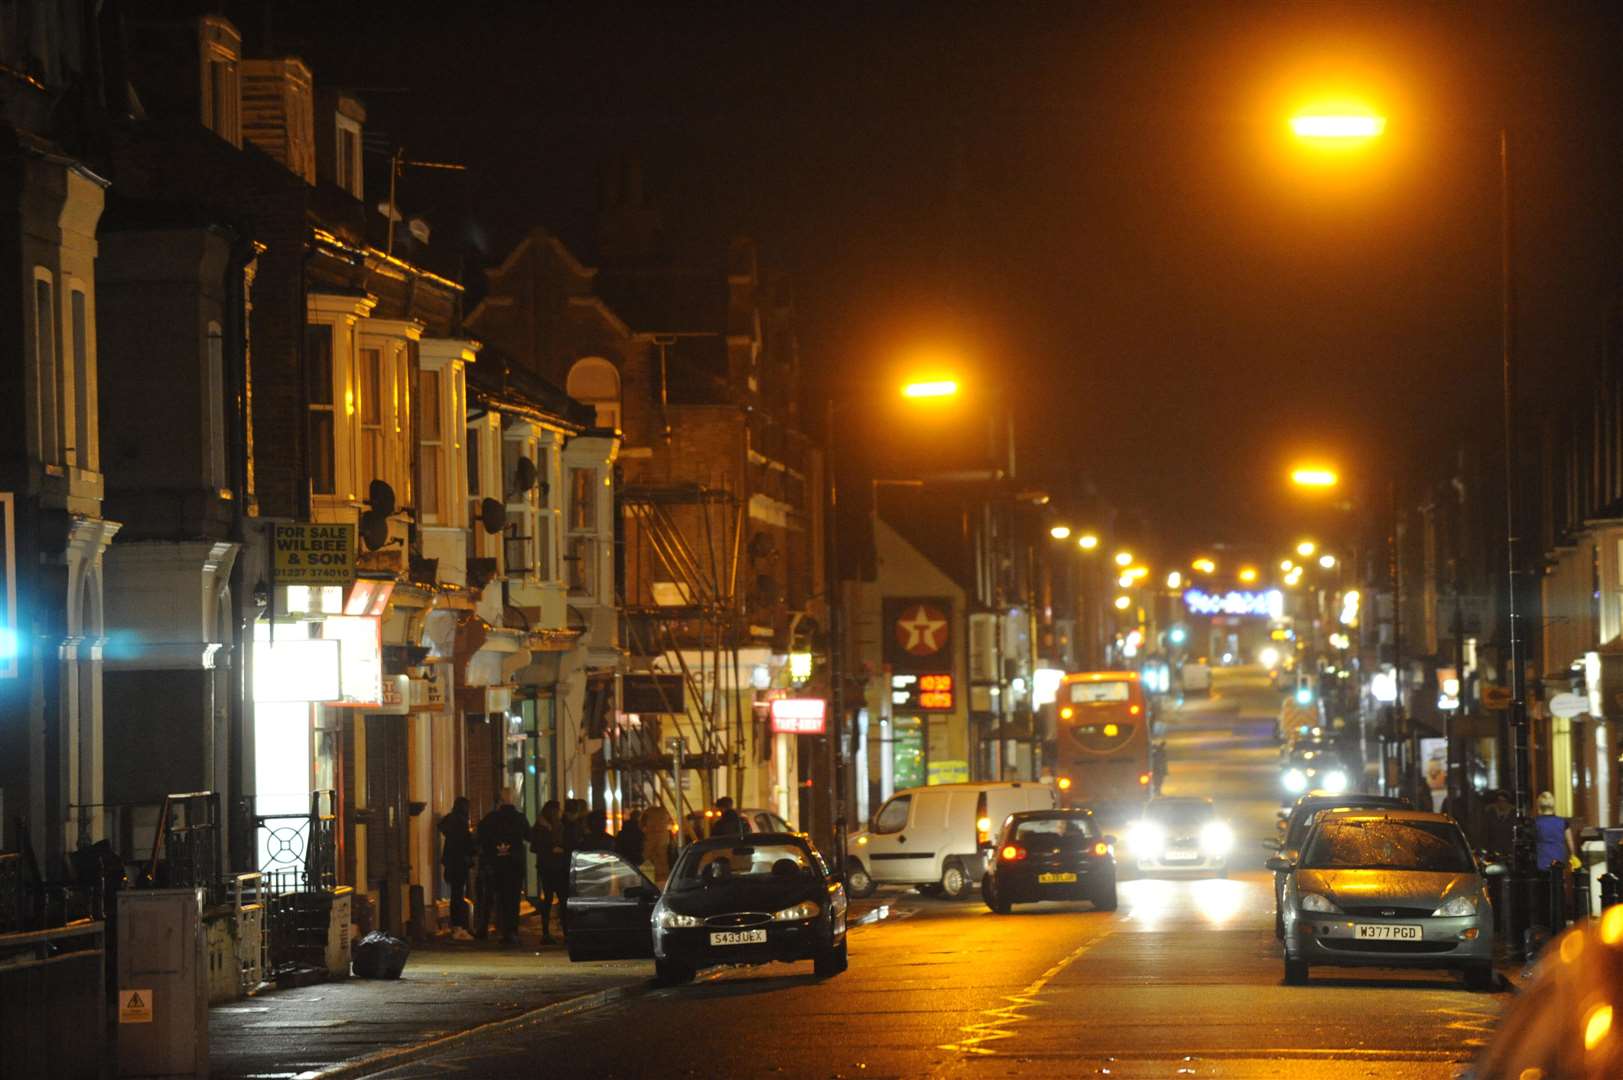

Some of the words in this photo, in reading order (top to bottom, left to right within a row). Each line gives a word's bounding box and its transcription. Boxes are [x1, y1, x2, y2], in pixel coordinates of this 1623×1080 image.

[276, 527, 305, 538] FOR
[310, 527, 347, 539] SALE
[276, 540, 348, 552] WILBEE
[288, 553, 301, 565] &
[308, 553, 347, 566] SON
[1360, 926, 1391, 937] W377
[1393, 927, 1416, 939] PGD
